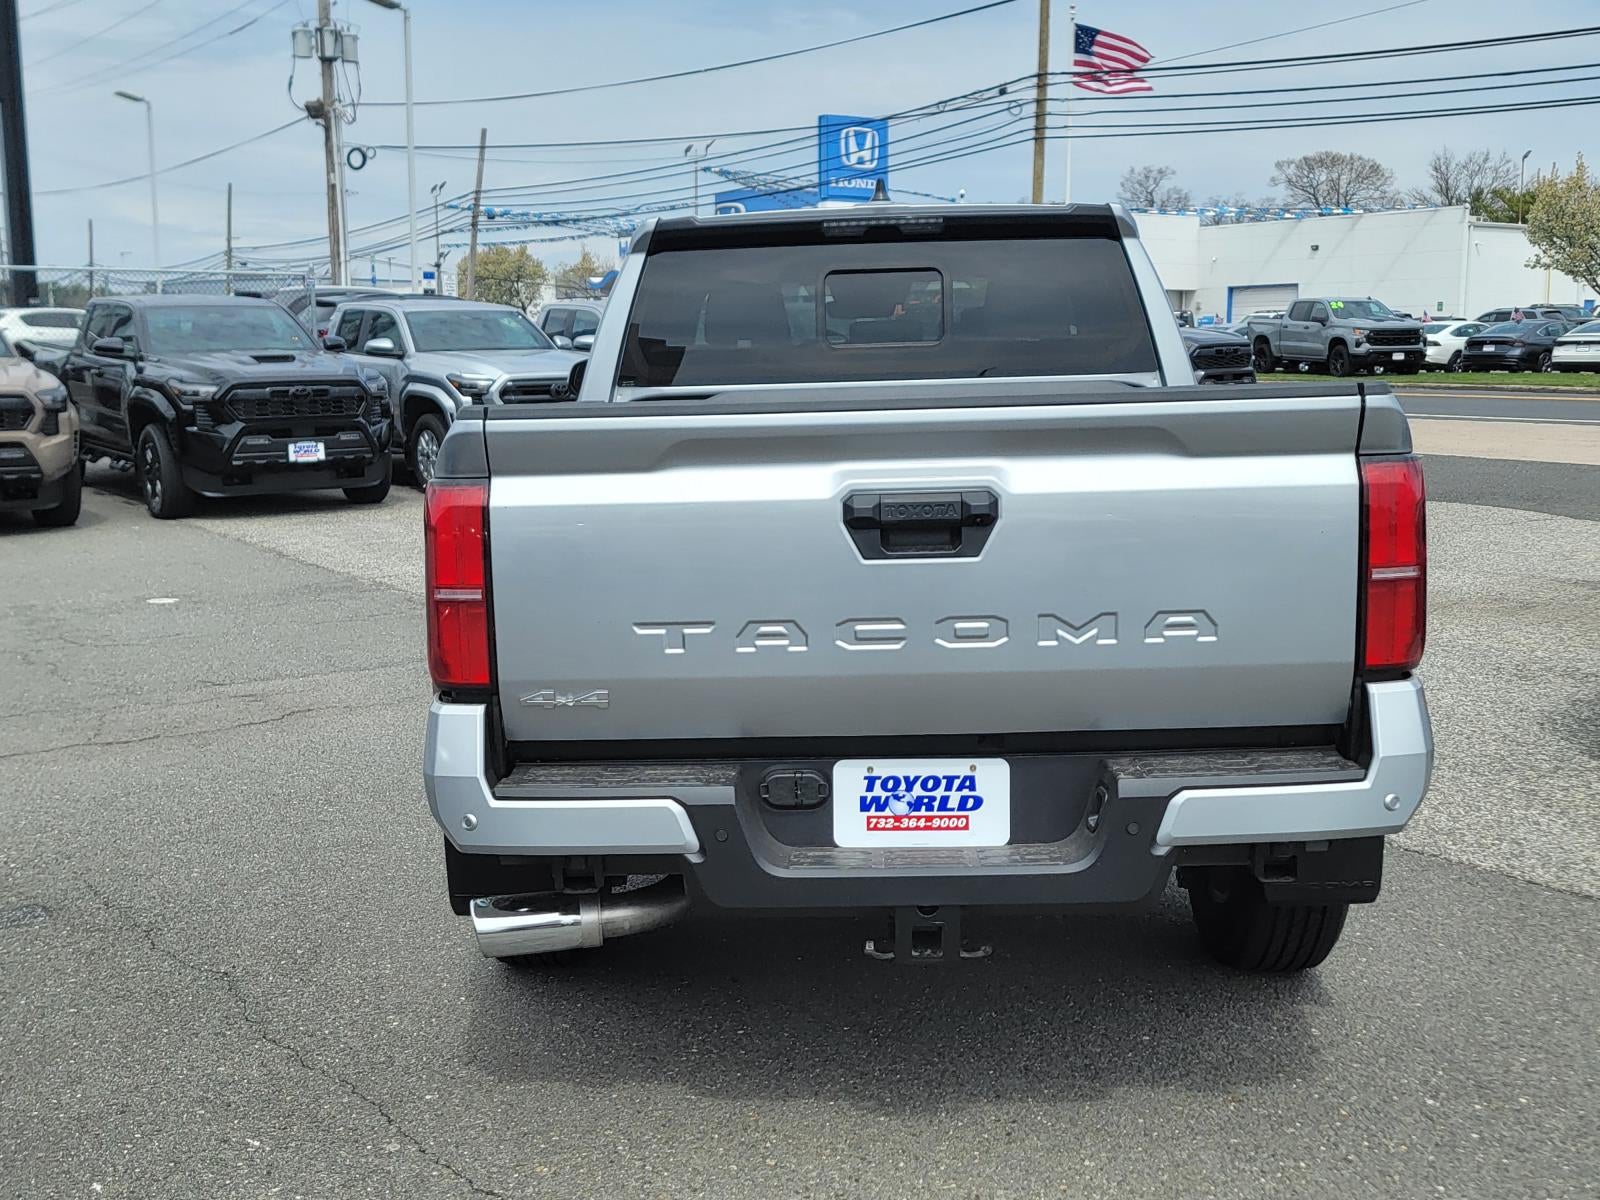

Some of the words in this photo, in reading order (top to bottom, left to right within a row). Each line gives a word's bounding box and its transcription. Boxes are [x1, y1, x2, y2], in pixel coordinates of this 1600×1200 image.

[831, 177, 876, 189] HOND
[884, 504, 958, 518] TOYOTA
[632, 609, 1218, 654] TACOMA
[863, 775, 977, 793] TOYOTA
[859, 794, 985, 813] WORLD
[868, 817, 967, 829] 732-364-9000
